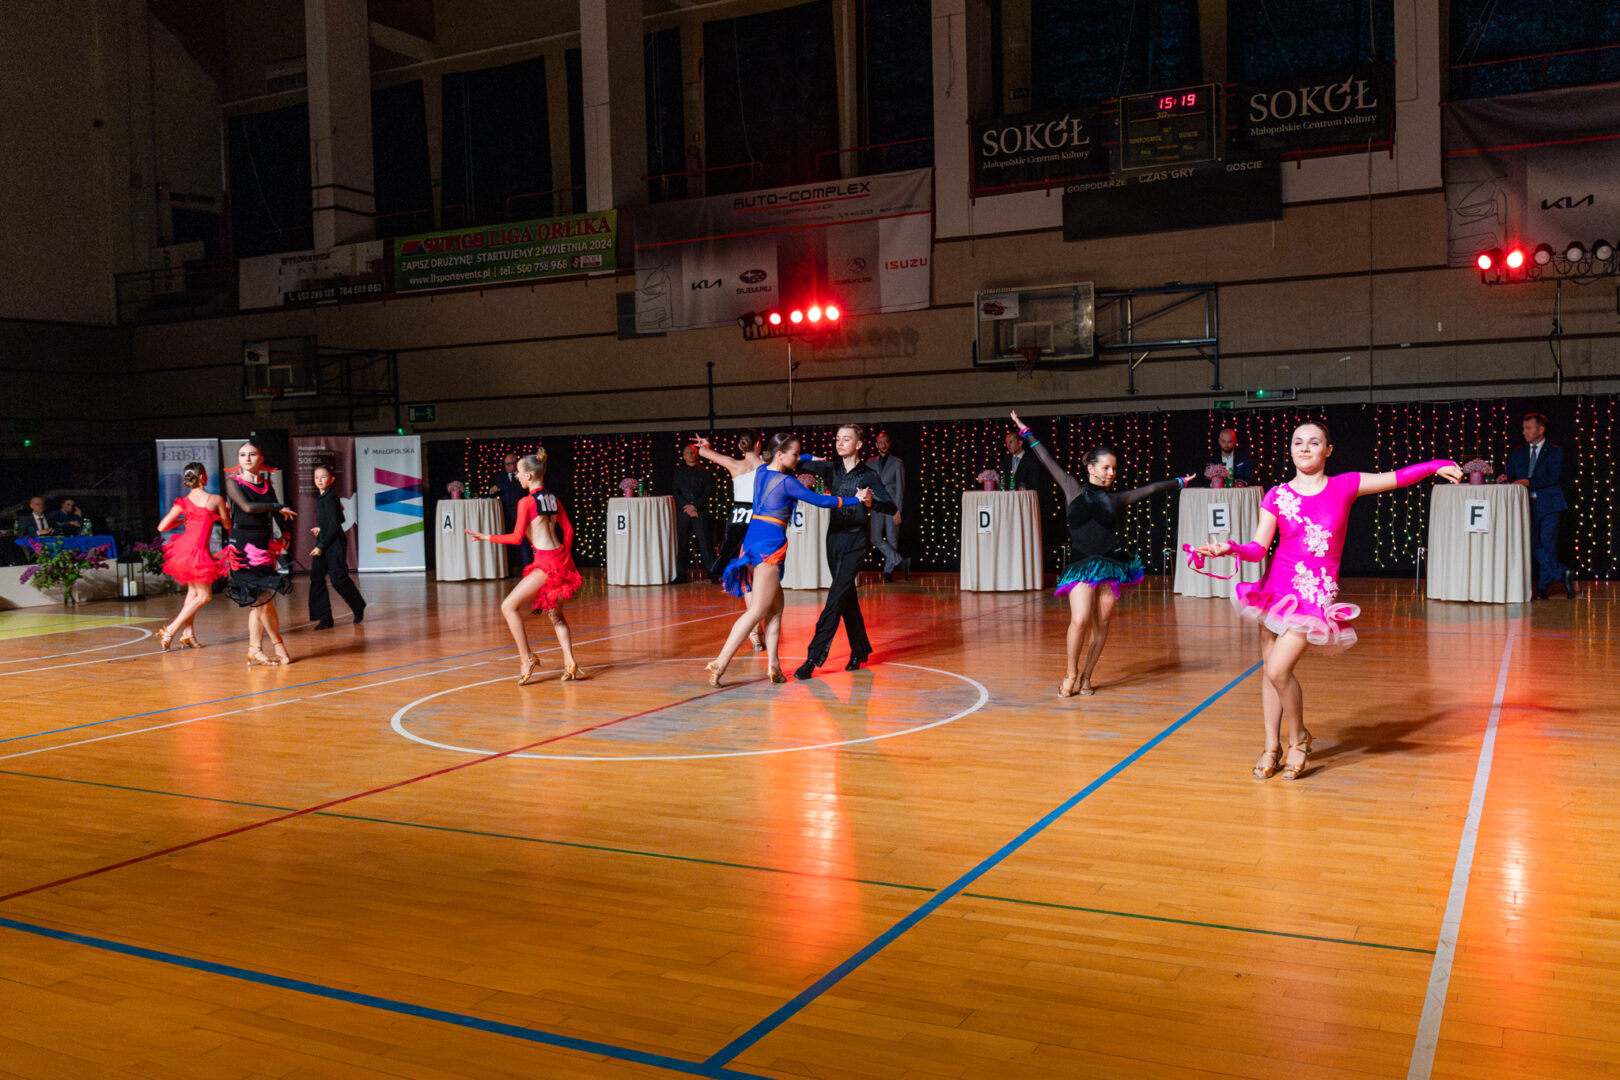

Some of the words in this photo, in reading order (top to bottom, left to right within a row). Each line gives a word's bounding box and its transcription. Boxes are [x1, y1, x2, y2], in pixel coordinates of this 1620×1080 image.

[1302, 119, 1342, 131] Centrum
[1344, 112, 1377, 125] Kultury
[1060, 150, 1089, 161] Kultury
[1138, 170, 1169, 184] CZAS
[1170, 167, 1196, 180] GRY
[733, 181, 872, 209] AUTO-COMPLEX
[1541, 194, 1594, 210] KIA
[488, 226, 533, 247] LIGA
[536, 217, 613, 241] ORLIKA
[401, 259, 430, 271] ZAPISZ
[476, 246, 534, 264] STARTUJEMY
[535, 246, 542, 257] 2
[542, 241, 588, 255] KWIETNIA
[589, 238, 613, 251] 2024
[516, 263, 533, 274] 500
[885, 257, 929, 270] ISUZU
[691, 278, 723, 290] KIA
[735, 285, 773, 294] SUBARU
[537, 494, 558, 511] 118
[443, 514, 453, 529] A
[617, 515, 626, 530] B
[793, 511, 803, 528] C
[980, 511, 991, 528] D
[1212, 509, 1225, 527] E
[1470, 506, 1485, 525] F
